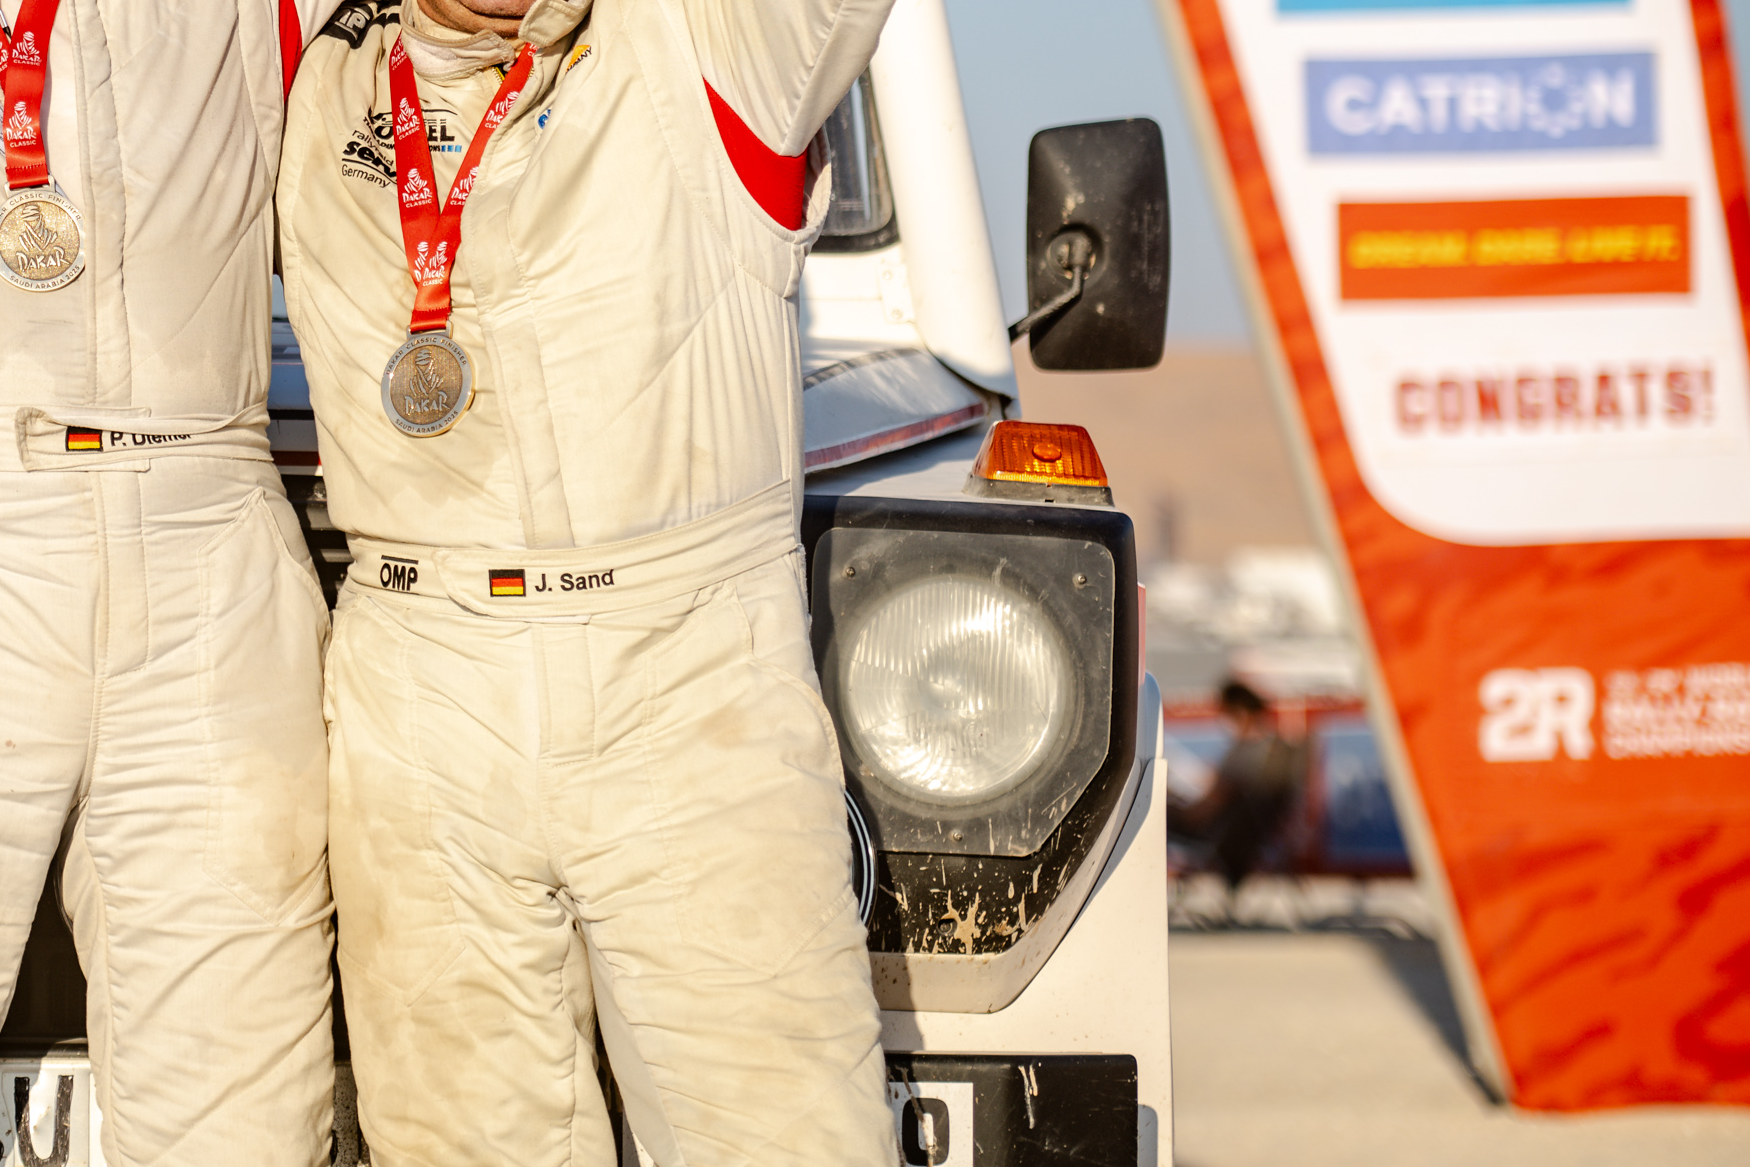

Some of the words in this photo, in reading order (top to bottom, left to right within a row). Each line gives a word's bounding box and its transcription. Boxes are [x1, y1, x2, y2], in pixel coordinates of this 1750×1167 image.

[12, 49, 41, 63] DAKAR
[1323, 60, 1637, 138] CATRION
[6, 126, 37, 141] DAKAR
[396, 115, 421, 136] DAKAR
[399, 125, 421, 140] CLASSIC
[10, 139, 37, 148] CLASSIC
[342, 165, 391, 189] Germany
[9, 192, 44, 206] CLASSIC
[402, 187, 432, 204] DAKAR
[405, 198, 433, 209] CLASSIC
[16, 245, 70, 272] DAKAR
[10, 275, 34, 289] SAUDI
[35, 278, 65, 290] ARABIA
[65, 264, 81, 280] 2025
[422, 278, 443, 287] CLASSIC
[423, 267, 445, 280] DAKAR
[386, 350, 405, 375] DAKAR
[406, 337, 438, 350] CLASSIC
[440, 338, 468, 366] FINISHER
[404, 390, 451, 415] DAKAR
[1394, 361, 1715, 436] CONGRATS!
[394, 418, 415, 433] SAUDI
[416, 423, 444, 433] ARABIA
[444, 410, 459, 425] 2025
[110, 431, 128, 447] P.
[380, 562, 418, 592] OMP
[535, 574, 553, 593] J.
[560, 569, 615, 592] Sand
[1477, 666, 1595, 763] 2R
